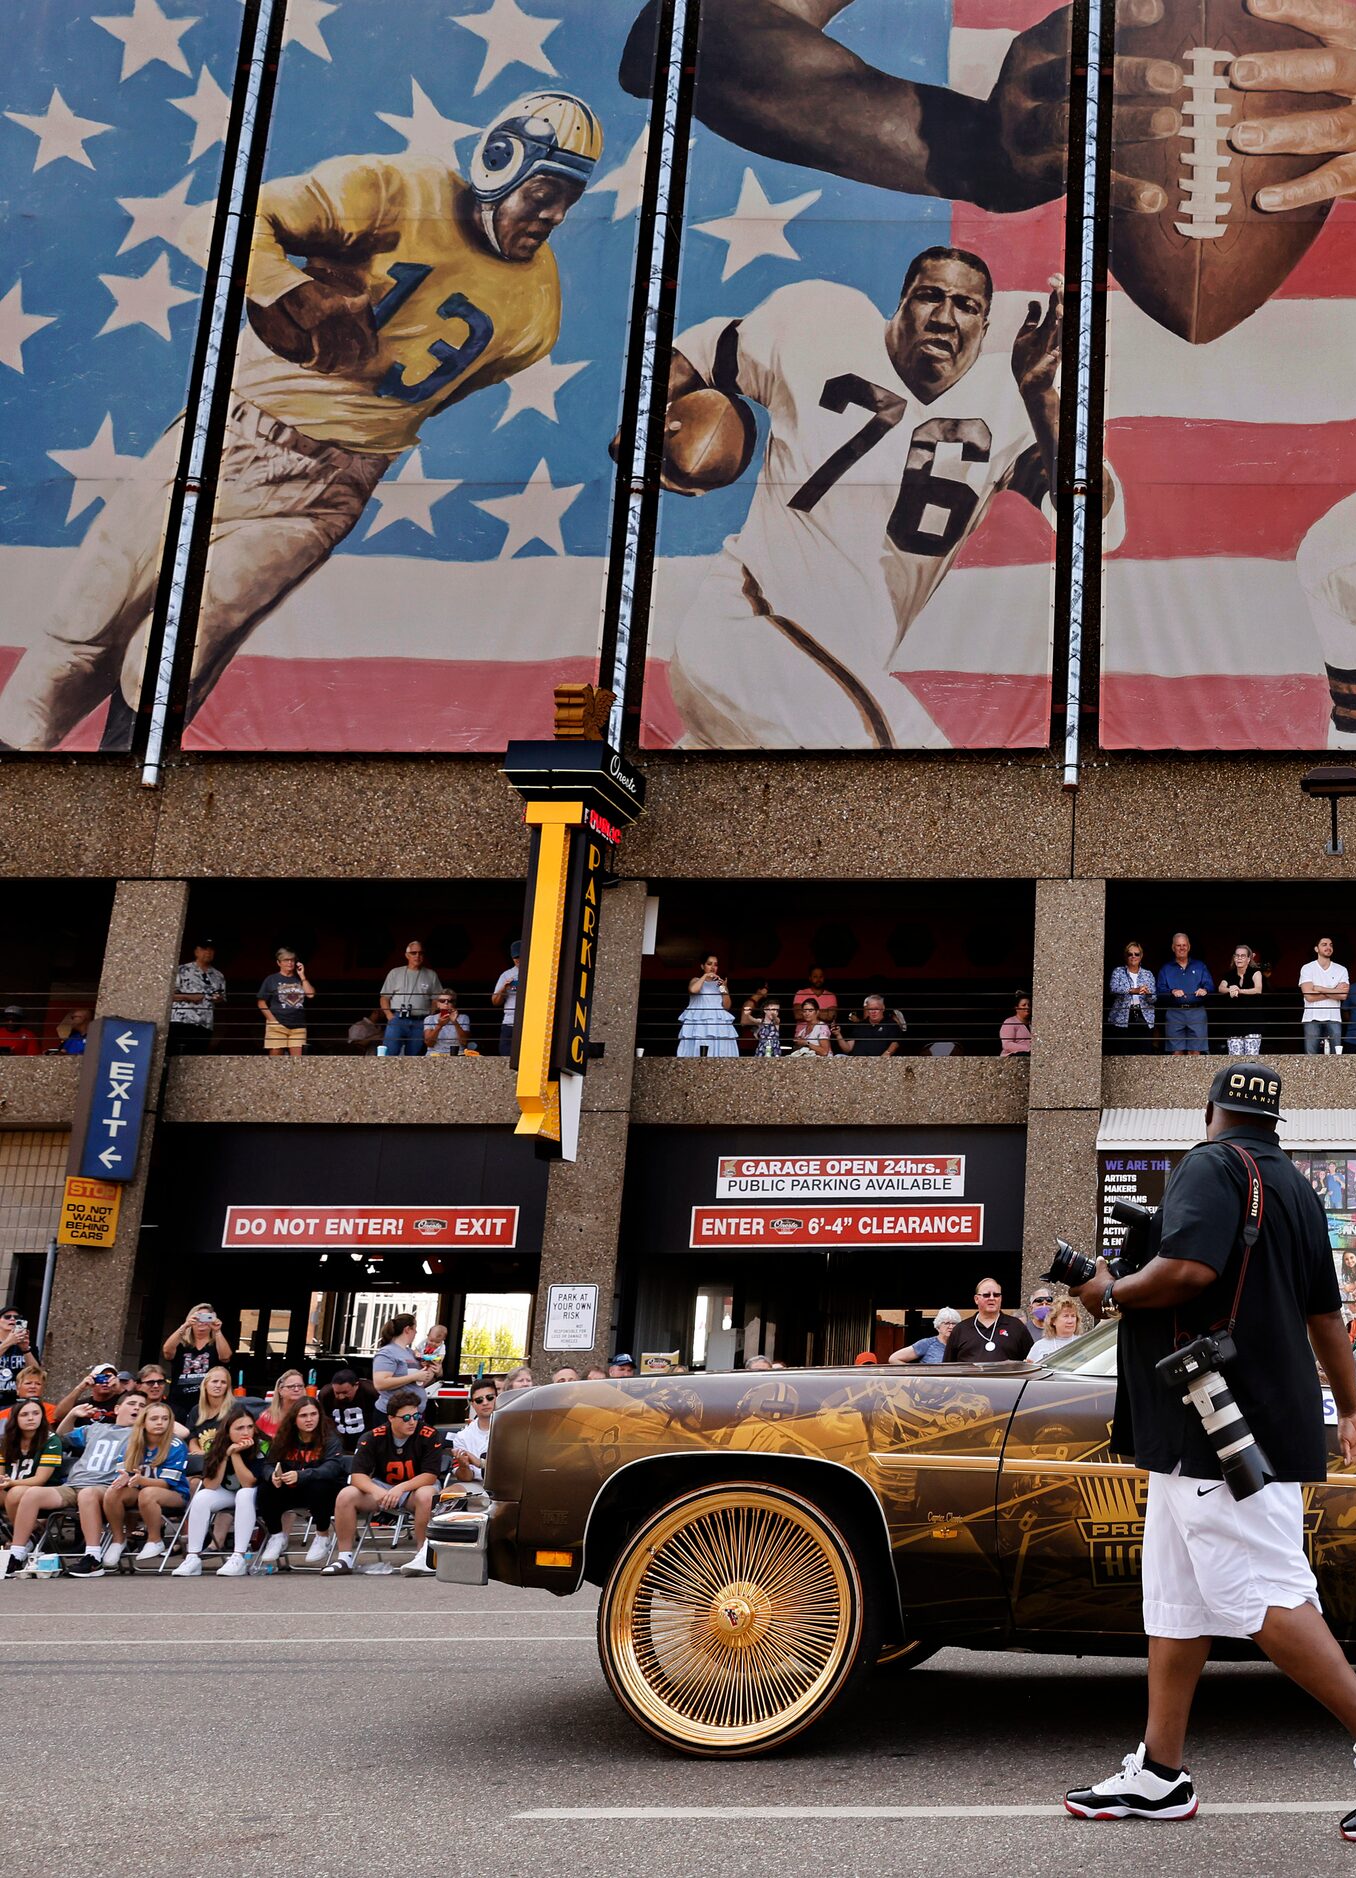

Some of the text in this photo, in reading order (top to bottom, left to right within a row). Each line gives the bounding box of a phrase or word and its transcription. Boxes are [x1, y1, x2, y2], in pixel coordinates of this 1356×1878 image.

[375, 261, 494, 403] 13
[787, 373, 993, 557] 76
[571, 843, 601, 1065] PARKING
[102, 1061, 136, 1137] EXIT
[741, 1160, 941, 1175] GARAGE OPEN 24hrs.
[1105, 1160, 1171, 1171] WE ARE THE
[727, 1177, 952, 1192] PUBLIC PARKING AVAILABLE
[1104, 1174, 1137, 1182] ARTISTS
[69, 1182, 116, 1197] STOP
[1104, 1185, 1137, 1193] MAKERS
[1250, 1178, 1260, 1217] Canon
[66, 1203, 113, 1215] DO NOT
[72, 1213, 107, 1224] WALK
[701, 1218, 764, 1236] ENTER
[858, 1216, 973, 1235] CLEARANCE
[65, 1221, 110, 1232] BEHIND
[235, 1218, 267, 1235] DO
[273, 1218, 320, 1235] NOT
[324, 1218, 404, 1235] ENTER!
[454, 1218, 507, 1236] EXIT
[70, 1230, 103, 1240] CARS
[1102, 1238, 1110, 1246] &
[1103, 1248, 1114, 1256] OF
[558, 1293, 577, 1301] PARK
[553, 1302, 591, 1310] YOUR OWN
[563, 1311, 580, 1319] RISK
[332, 1407, 365, 1434] 19
[86, 1440, 120, 1471] 81
[10, 1460, 34, 1480] 12
[386, 1460, 415, 1485] 21
[1104, 1545, 1142, 1577] HA
